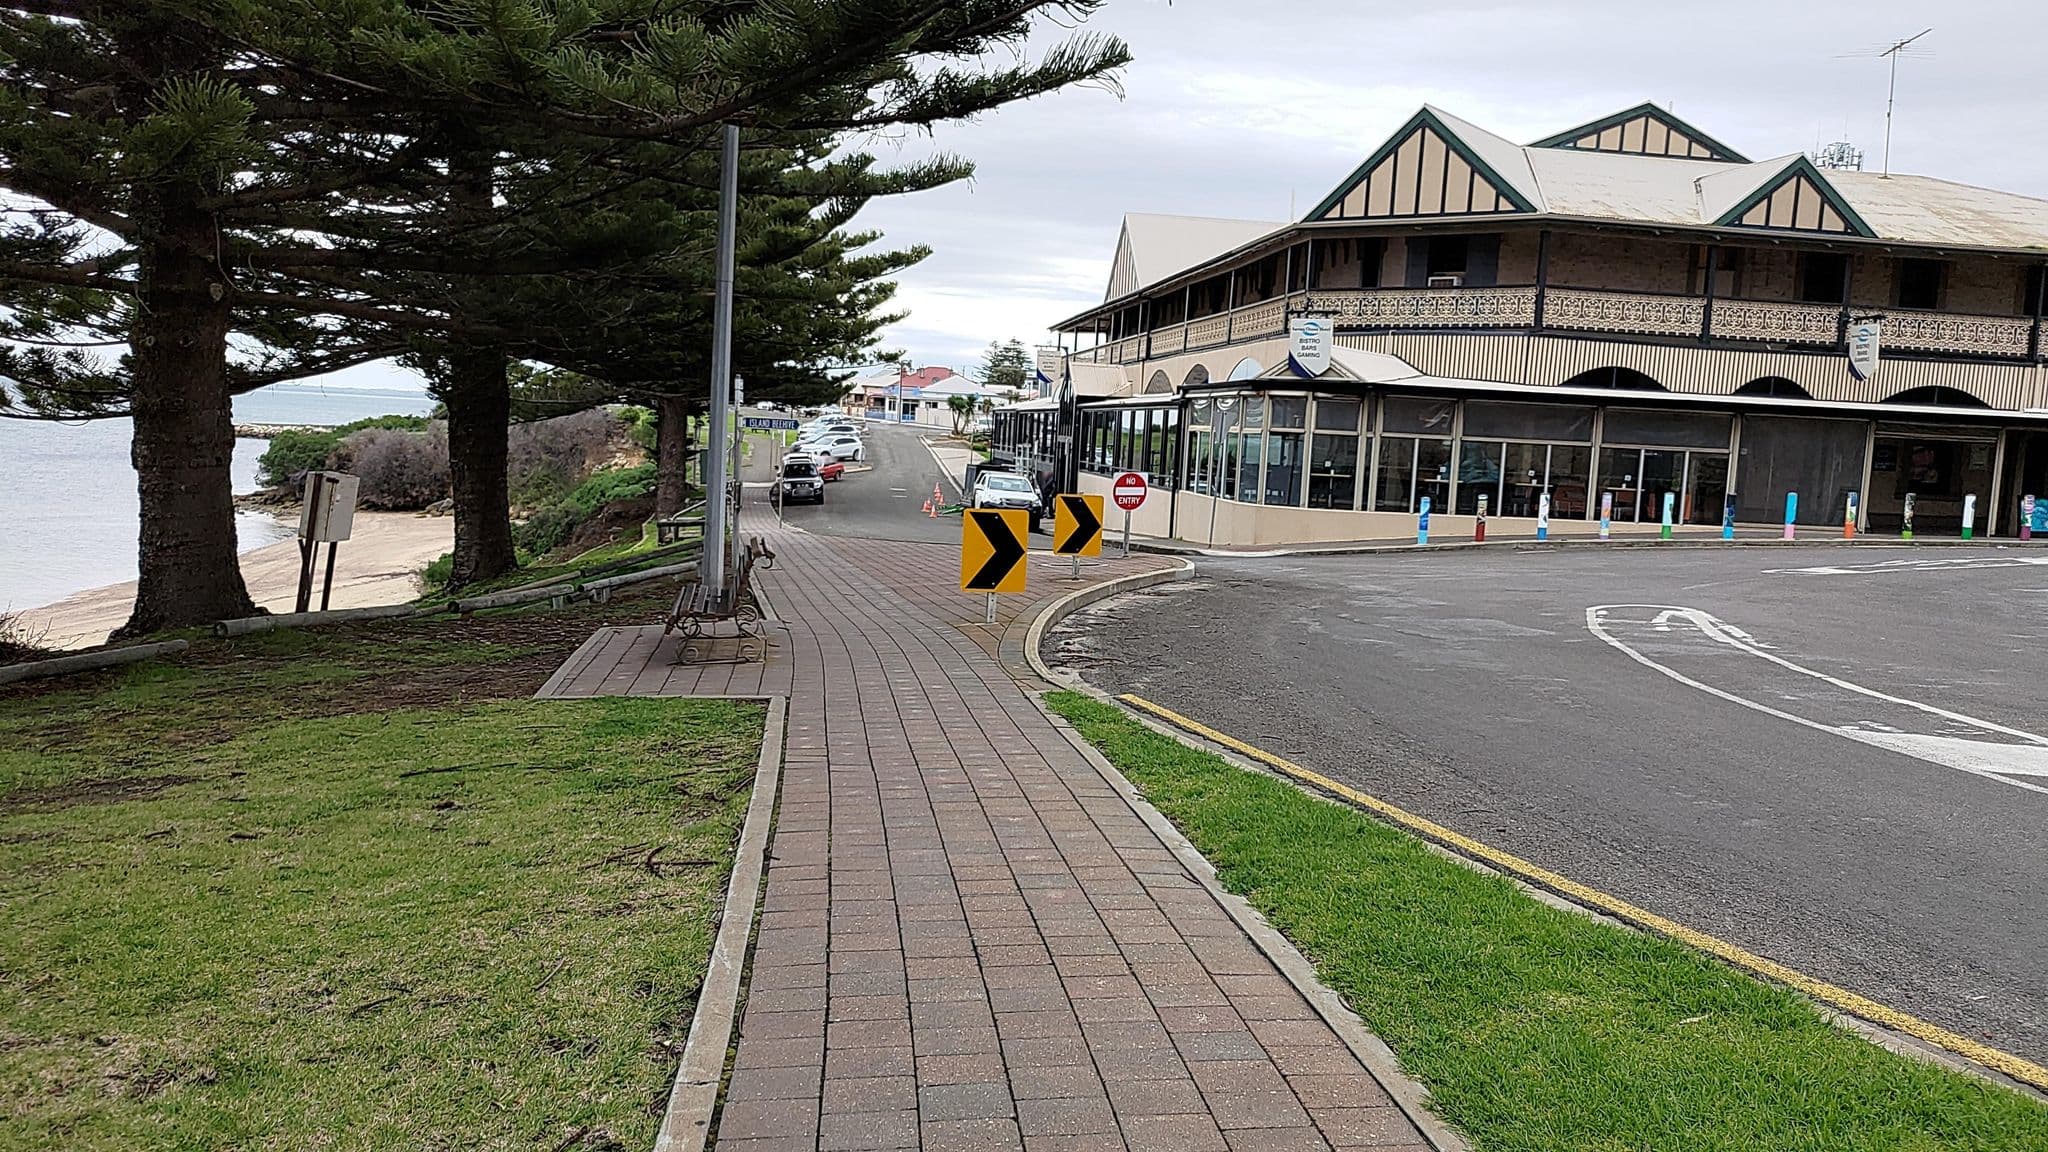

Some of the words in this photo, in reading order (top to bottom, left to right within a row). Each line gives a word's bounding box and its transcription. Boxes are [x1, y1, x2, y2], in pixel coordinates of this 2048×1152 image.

[749, 418, 770, 428] ISLAND
[771, 419, 795, 429] BEEHIVE
[1126, 478, 1136, 486] NO
[1118, 496, 1140, 504] ENTRY
